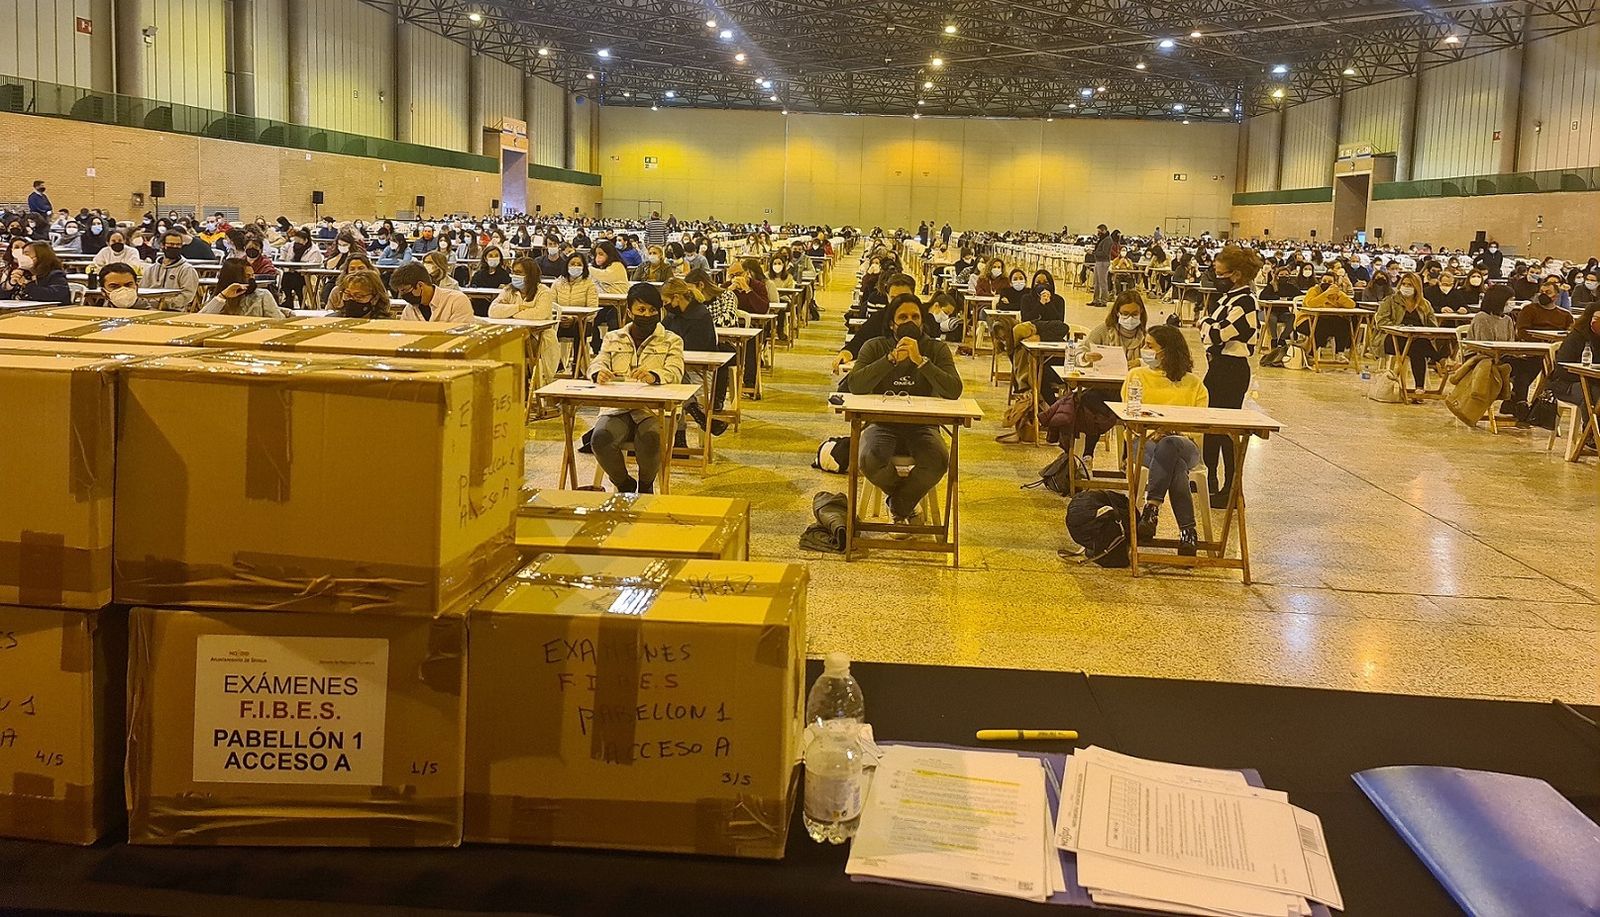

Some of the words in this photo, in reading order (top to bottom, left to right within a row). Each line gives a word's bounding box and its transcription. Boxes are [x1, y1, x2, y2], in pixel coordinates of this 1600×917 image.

[224, 672, 358, 695] EXÁMENES
[240, 701, 341, 719] F.I.B.E.S.
[717, 702, 732, 721] 1
[214, 727, 344, 749] PABELLÓN
[353, 732, 362, 750] 1
[715, 736, 730, 757] A
[36, 750, 64, 766] 4/5
[224, 752, 327, 771] ACCESO
[334, 754, 351, 771] A
[411, 761, 439, 775] 1/5
[722, 772, 751, 785] 3/5
